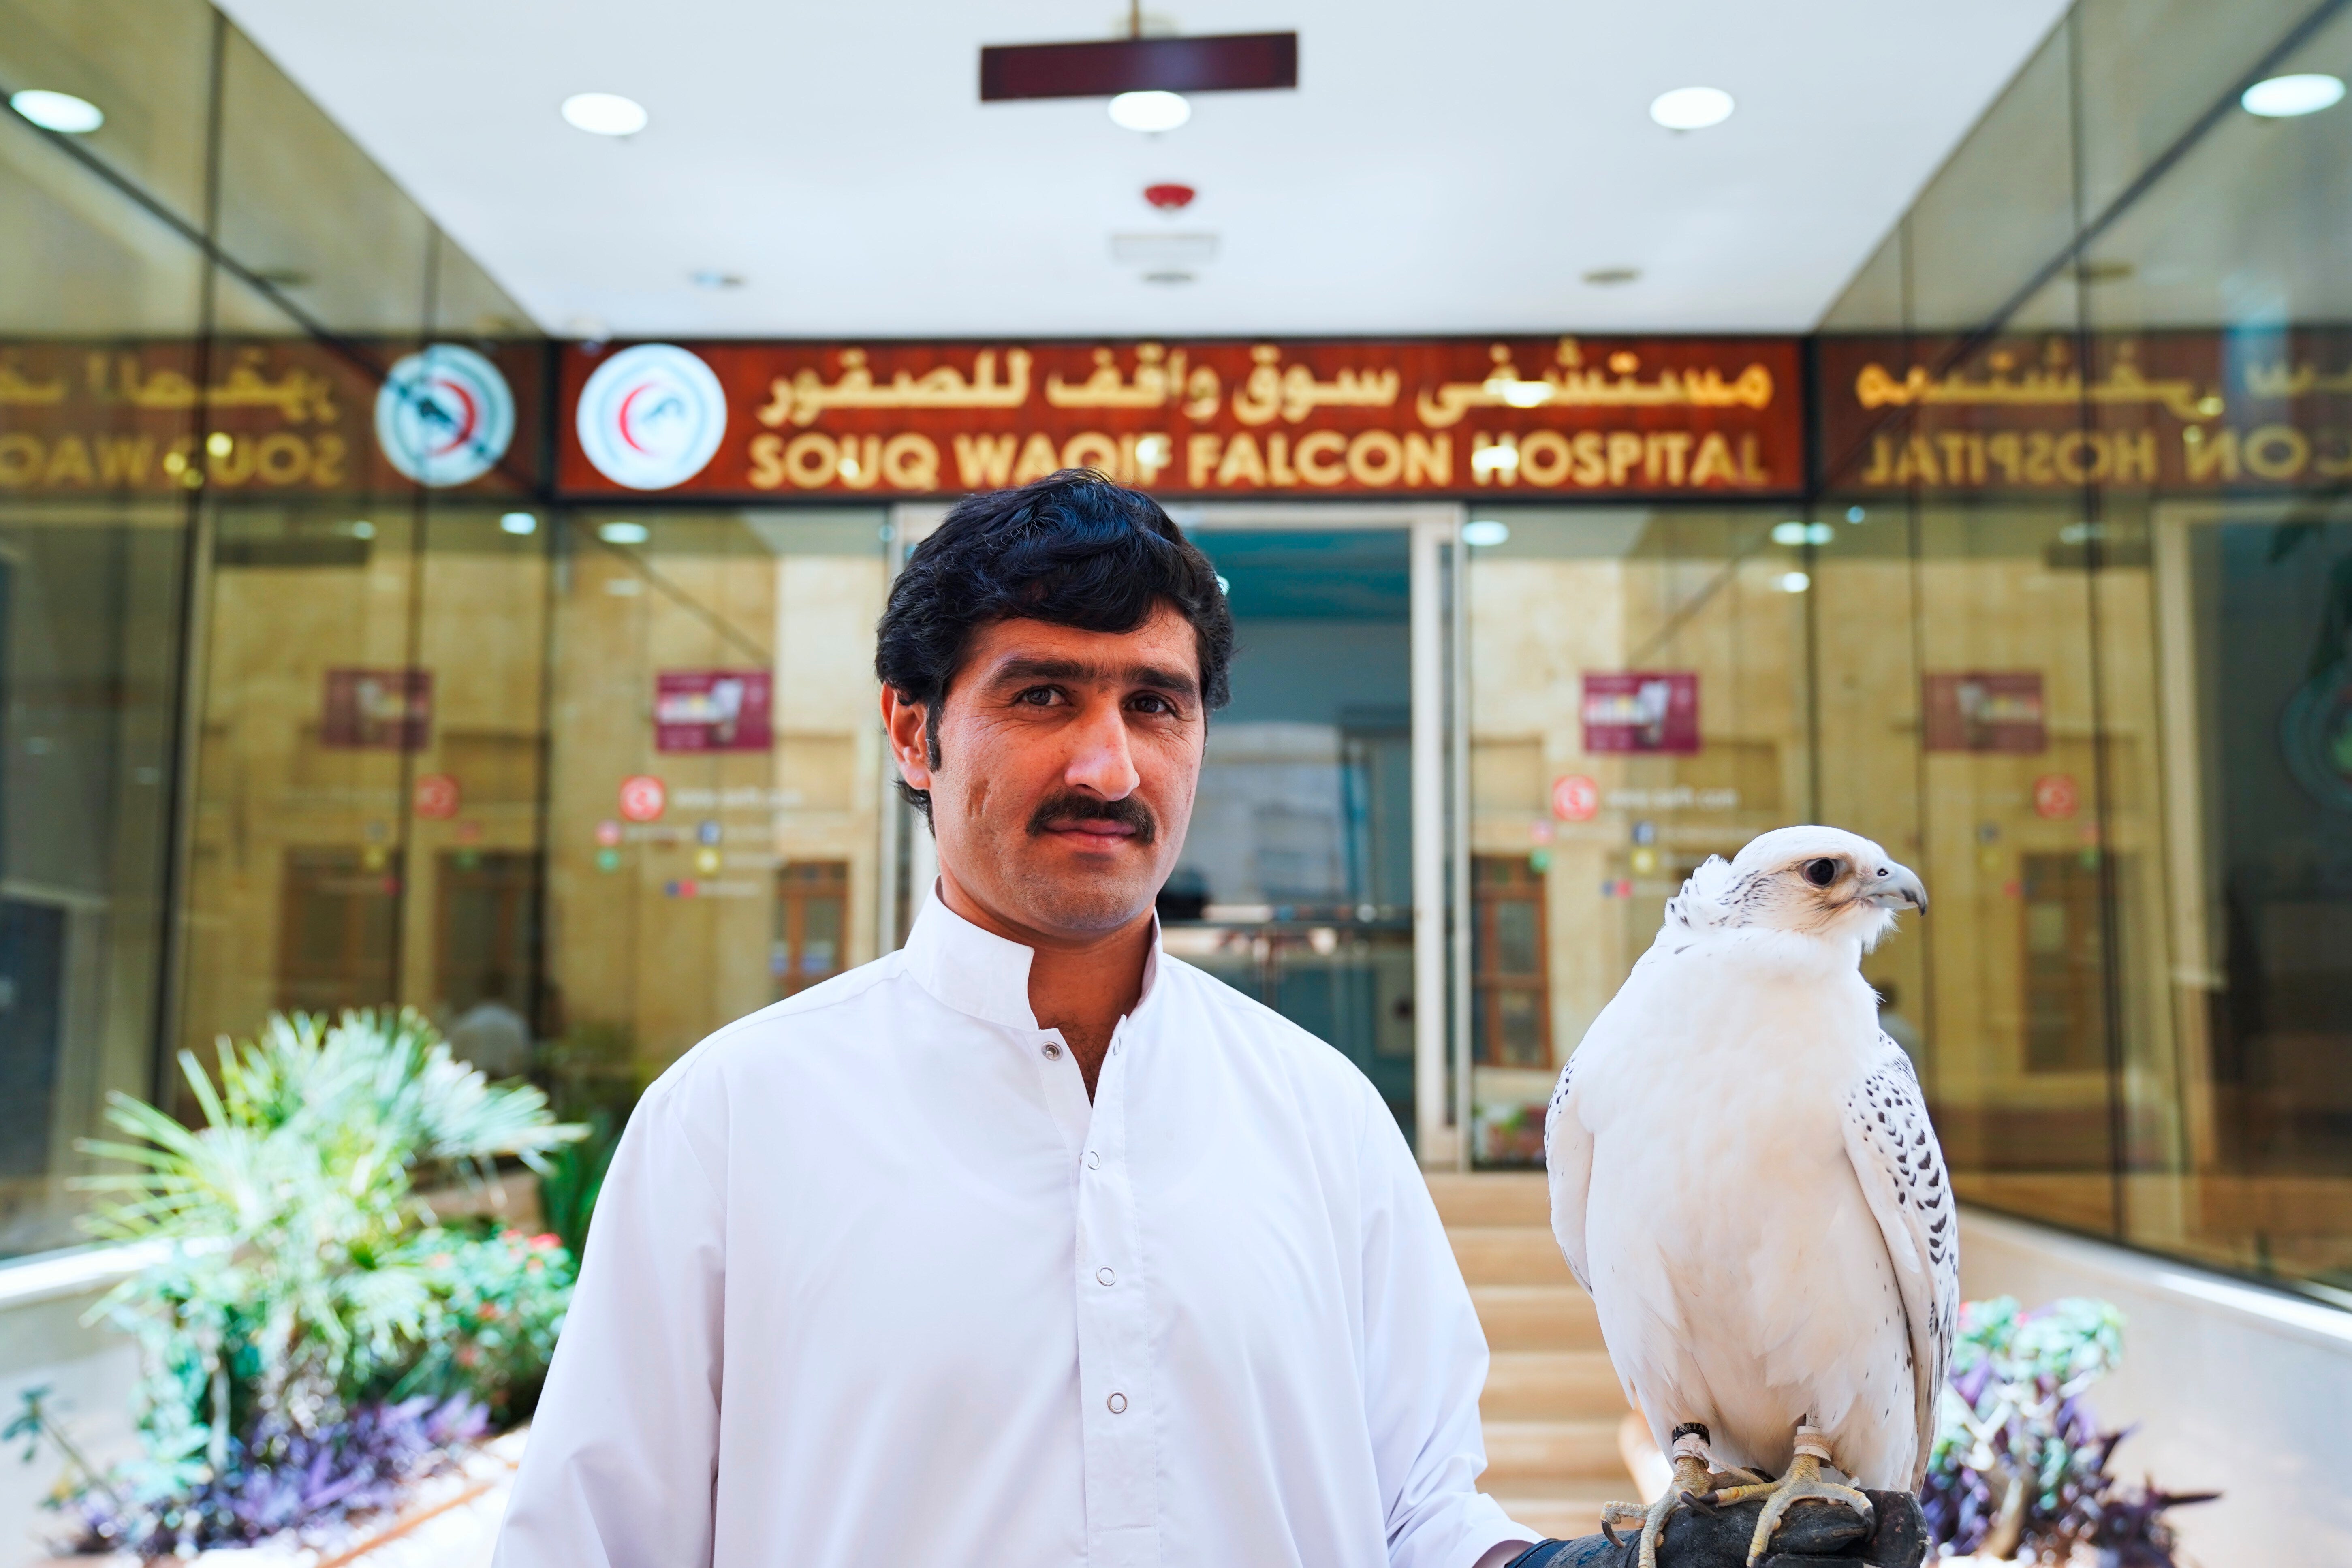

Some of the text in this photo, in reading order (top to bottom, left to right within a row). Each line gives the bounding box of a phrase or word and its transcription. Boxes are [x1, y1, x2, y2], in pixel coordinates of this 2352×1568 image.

[1045, 342, 1221, 422] واقف
[1231, 344, 1401, 426] سوق
[748, 429, 1768, 491] SOUQ WAQIF FALCON HOSPITAL
